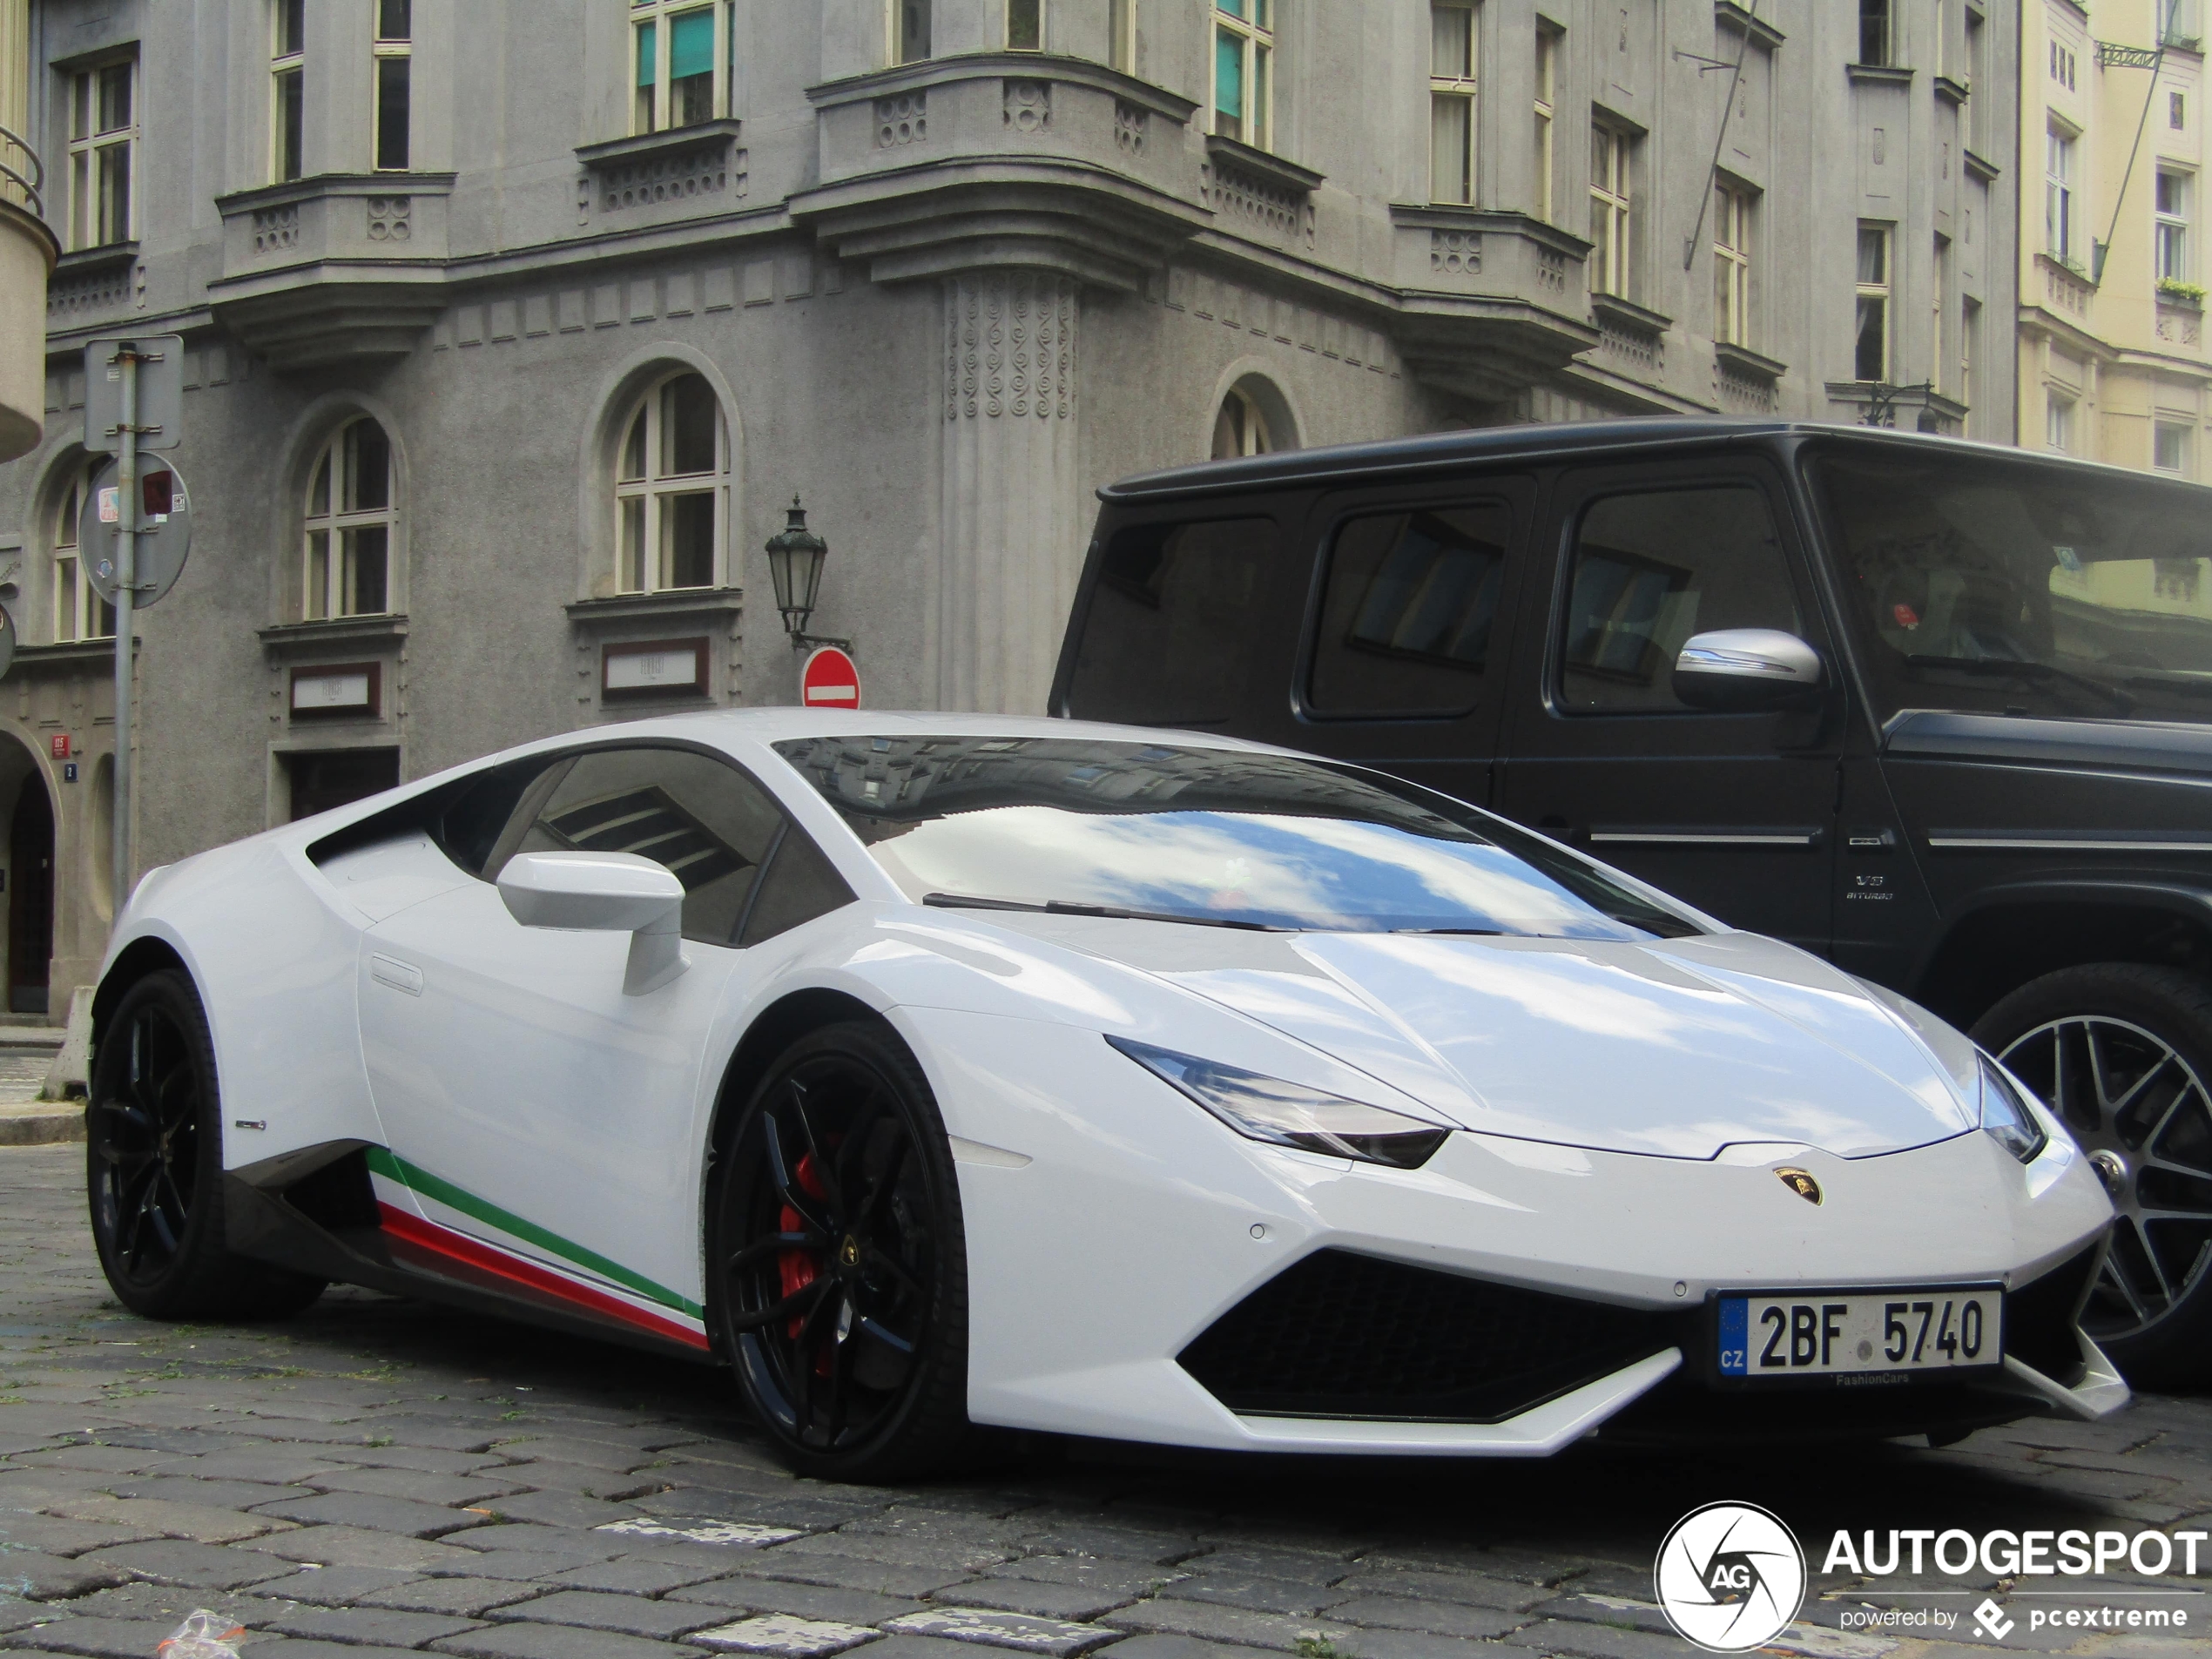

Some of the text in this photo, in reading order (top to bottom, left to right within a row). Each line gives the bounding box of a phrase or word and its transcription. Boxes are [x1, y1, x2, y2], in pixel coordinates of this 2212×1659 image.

[1760, 1299, 1983, 1367] 2BF 5740
[1721, 1350, 1743, 1368] CZ
[1836, 1372, 1910, 1386] FashionCars
